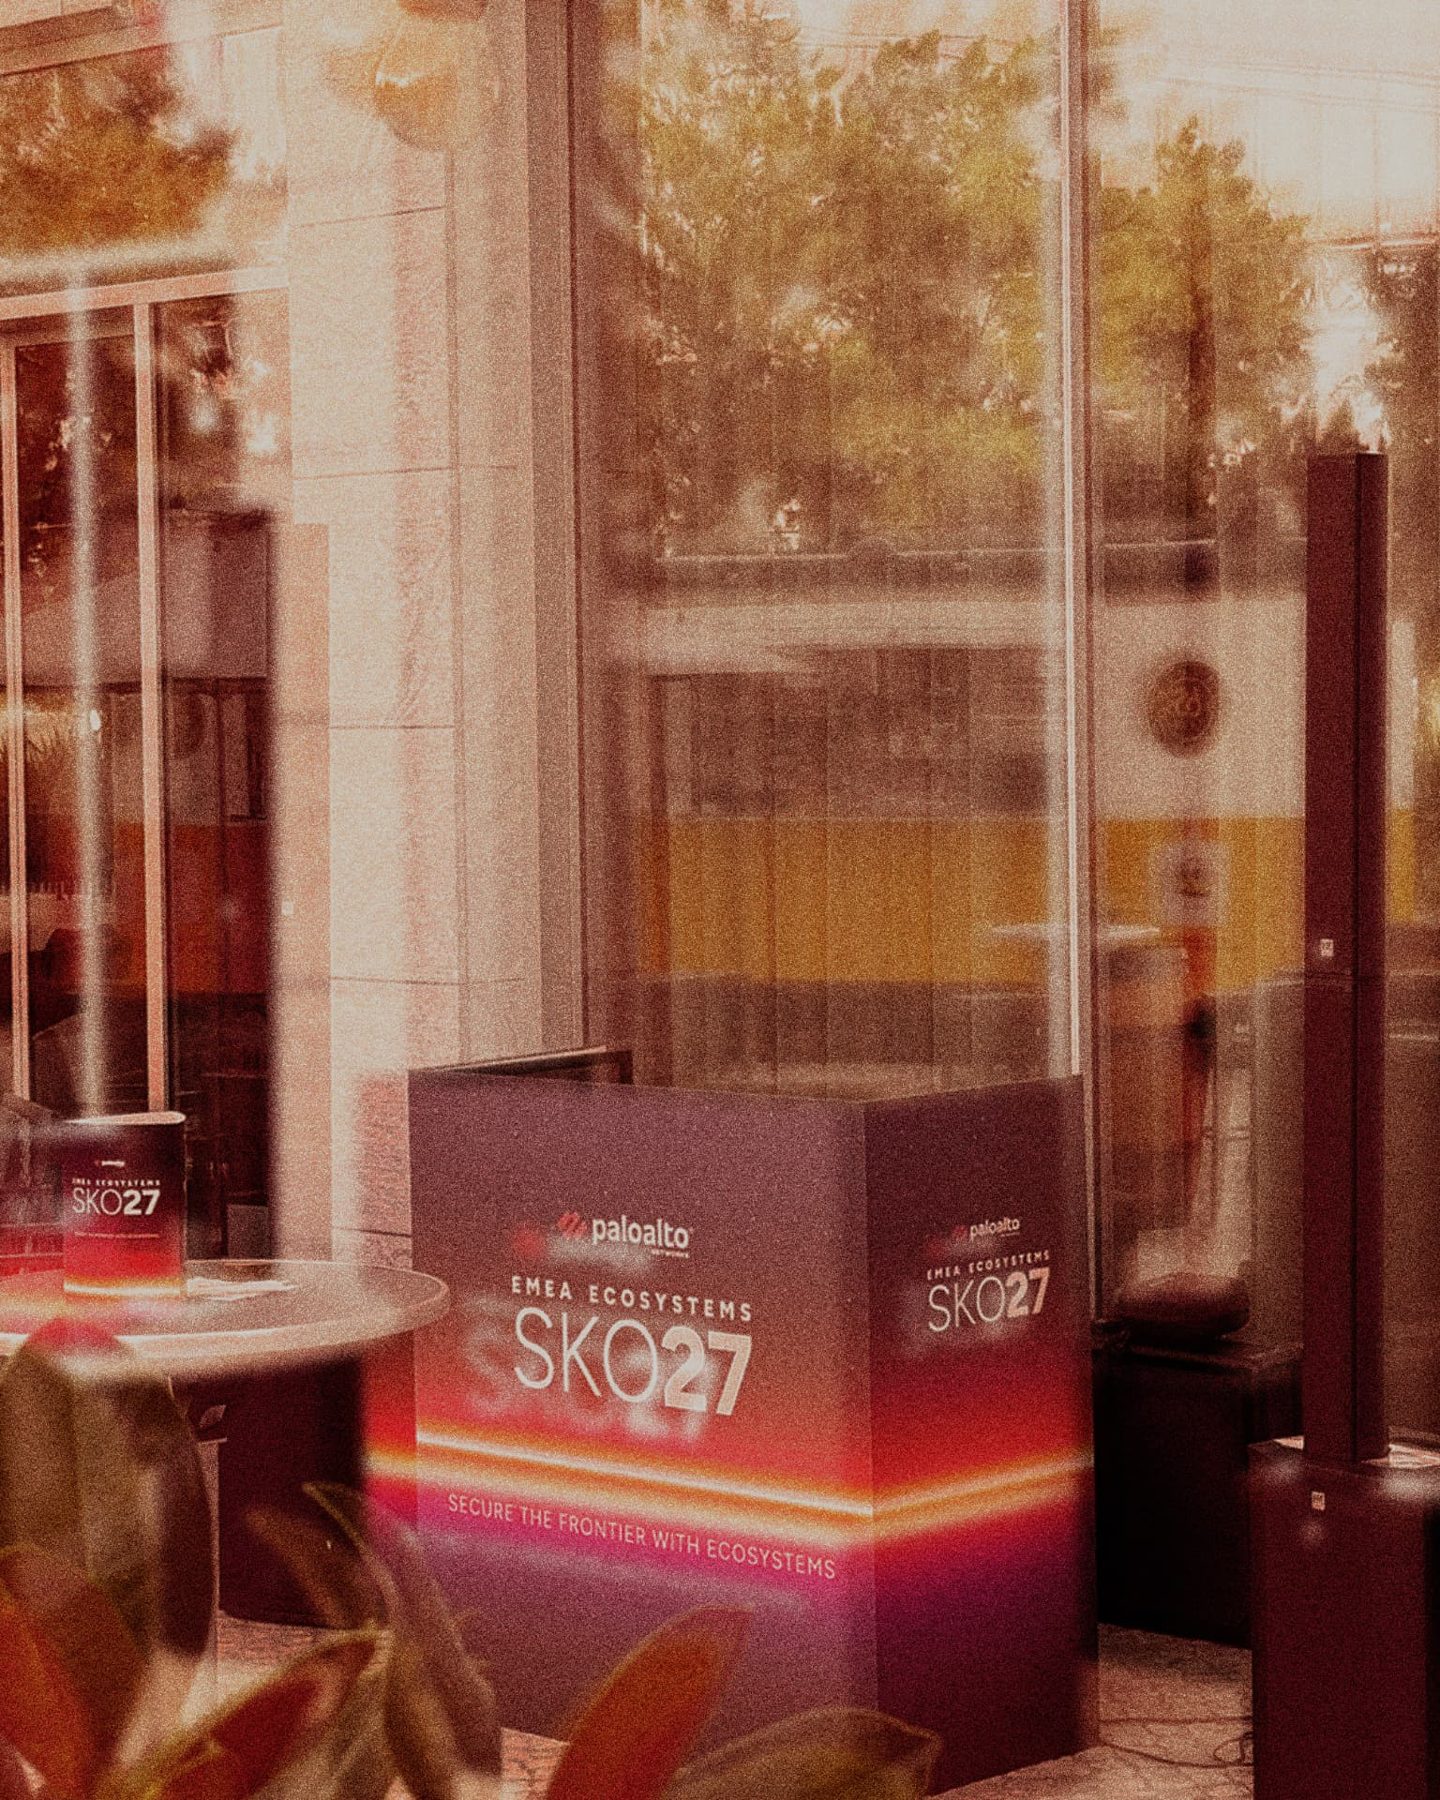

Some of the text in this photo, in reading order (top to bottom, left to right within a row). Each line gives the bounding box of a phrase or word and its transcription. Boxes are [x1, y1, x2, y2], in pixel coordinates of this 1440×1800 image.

[72, 1187, 160, 1216] SKO27
[592, 1214, 689, 1249] paloalto
[927, 1250, 1049, 1281] EMEA ECOSYSTEMS
[511, 1275, 752, 1322] EMEA ECOSYSTEMS
[928, 1267, 1050, 1331] SKO27
[514, 1306, 752, 1416] SKO27
[448, 1494, 836, 1580] SECURE THE FRONTIER WITH ECOSYSTEMS
